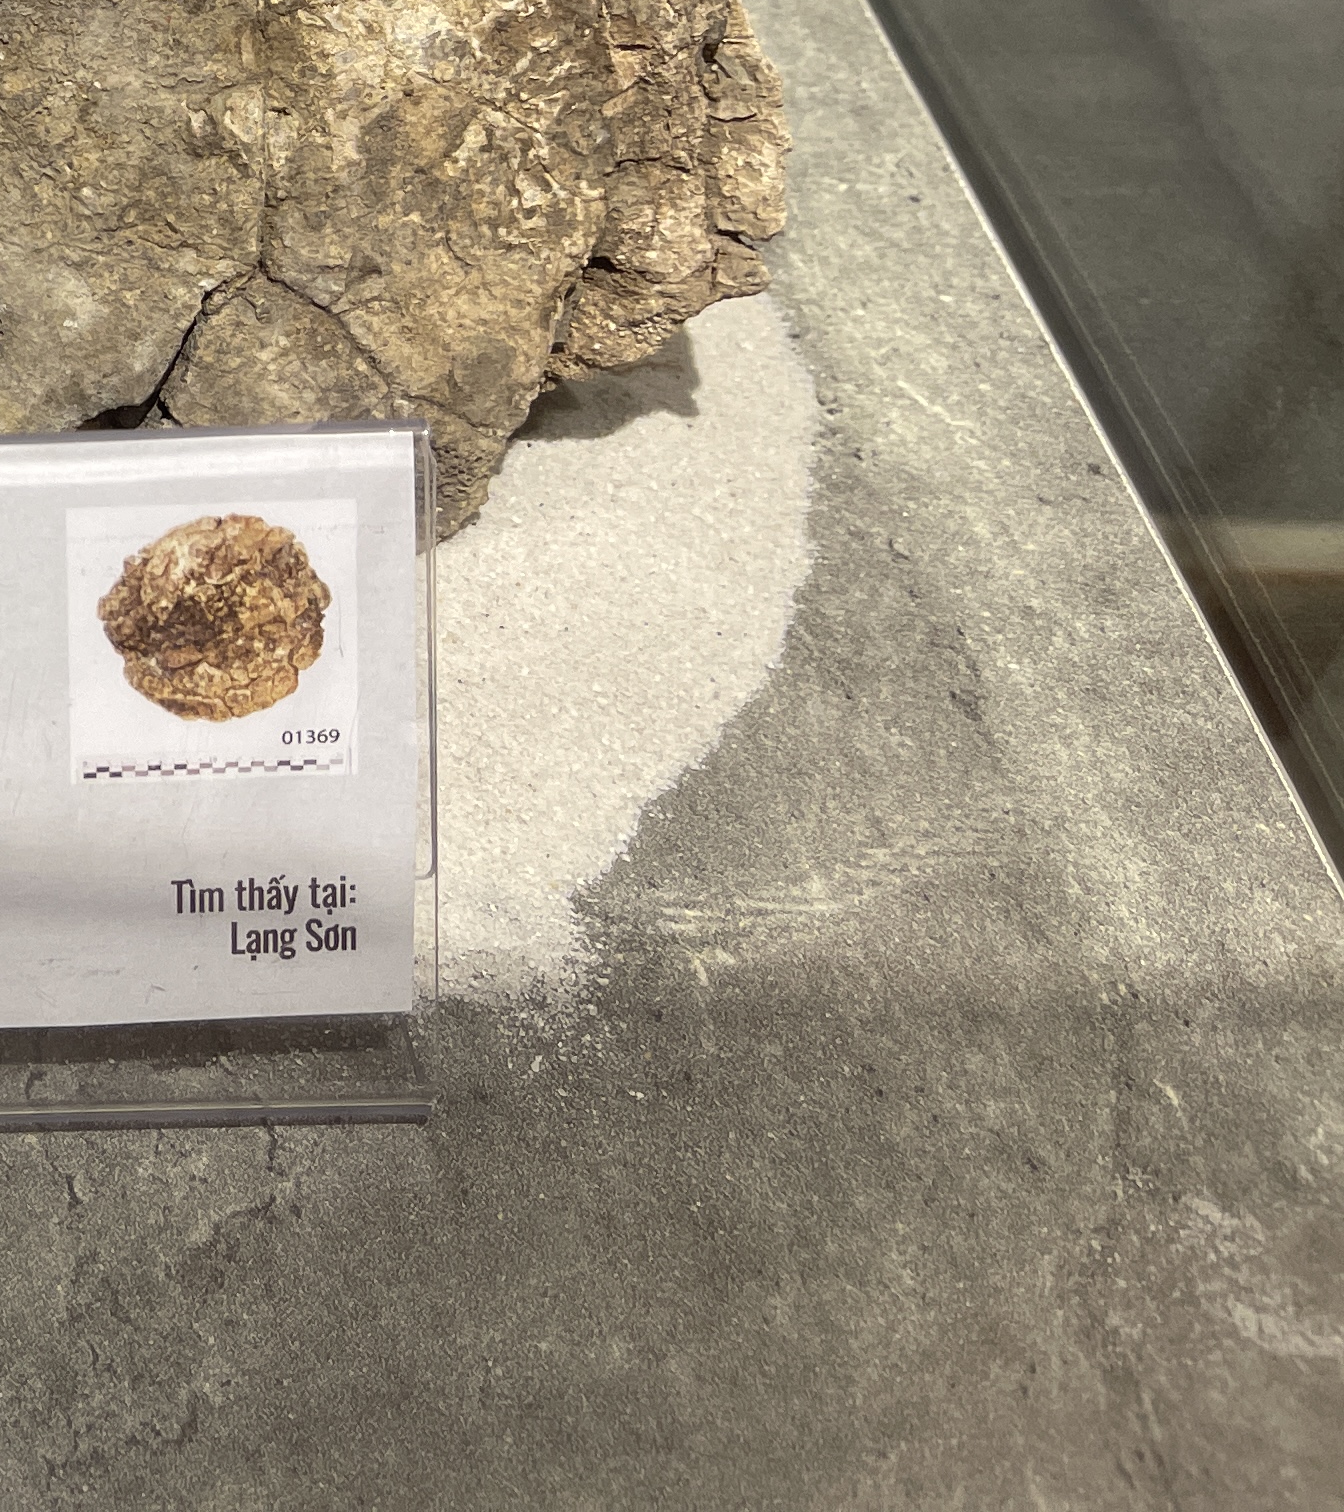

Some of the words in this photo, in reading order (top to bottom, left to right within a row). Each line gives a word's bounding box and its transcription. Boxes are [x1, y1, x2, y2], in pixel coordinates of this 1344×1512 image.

[281, 728, 341, 745] 01369
[170, 878, 225, 915] Tìm
[234, 874, 300, 916] thấy
[308, 875, 357, 916] tại:
[230, 921, 298, 962] Lạng
[305, 918, 357, 953] Sơn
